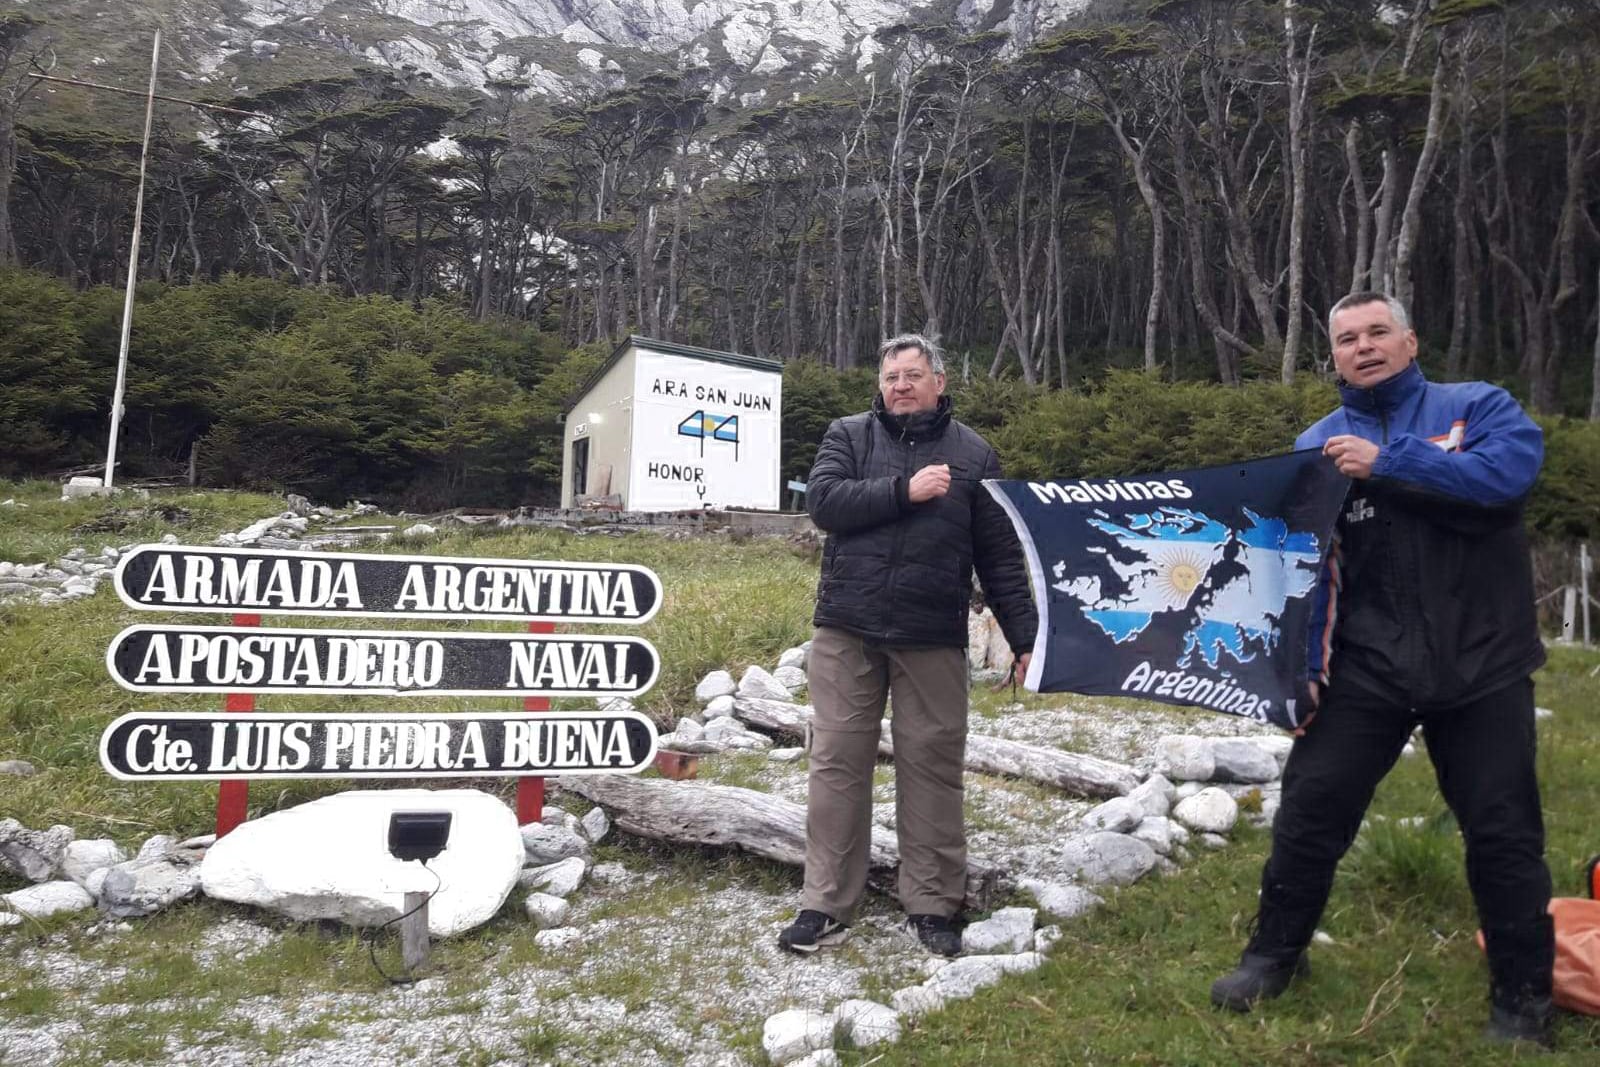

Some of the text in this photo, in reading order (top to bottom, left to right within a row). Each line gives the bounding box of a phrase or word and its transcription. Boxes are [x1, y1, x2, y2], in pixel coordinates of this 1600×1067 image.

[695, 385, 727, 404] SAN
[733, 392, 771, 411] JUAN
[648, 462, 704, 483] HONOR
[696, 484, 706, 500] Y
[1027, 477, 1194, 505] Malvinas
[140, 554, 640, 617] ARMADA ARGENTINA
[134, 633, 638, 690] APOSTADERO NAVAL
[1121, 660, 1272, 725] Argentinas
[126, 720, 636, 772] Cte. LUIS PIEDRA BUENA
